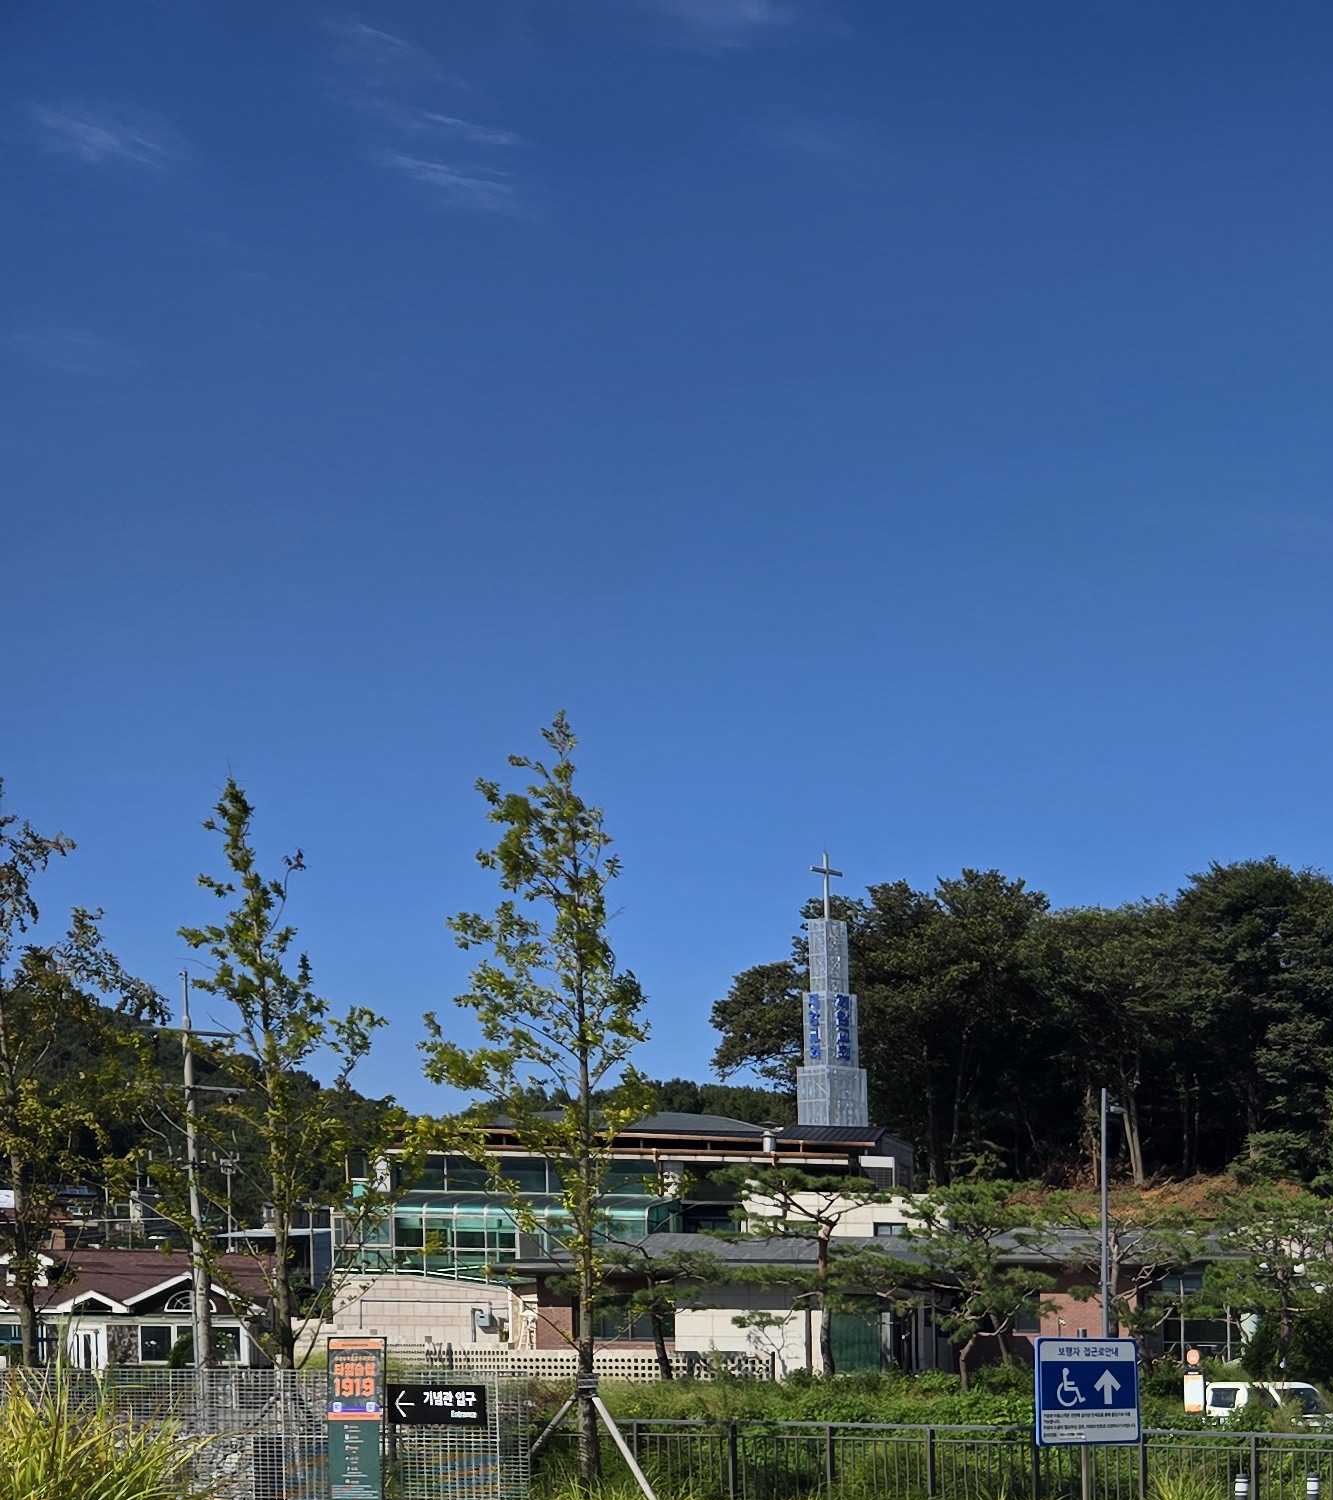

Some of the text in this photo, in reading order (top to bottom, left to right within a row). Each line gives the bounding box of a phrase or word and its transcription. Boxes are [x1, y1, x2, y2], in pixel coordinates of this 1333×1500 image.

[1058, 1347, 1118, 1356] 보행자 접근로안내
[334, 1377, 374, 1397] 1919
[423, 1391, 476, 1406] 기념관 입구
